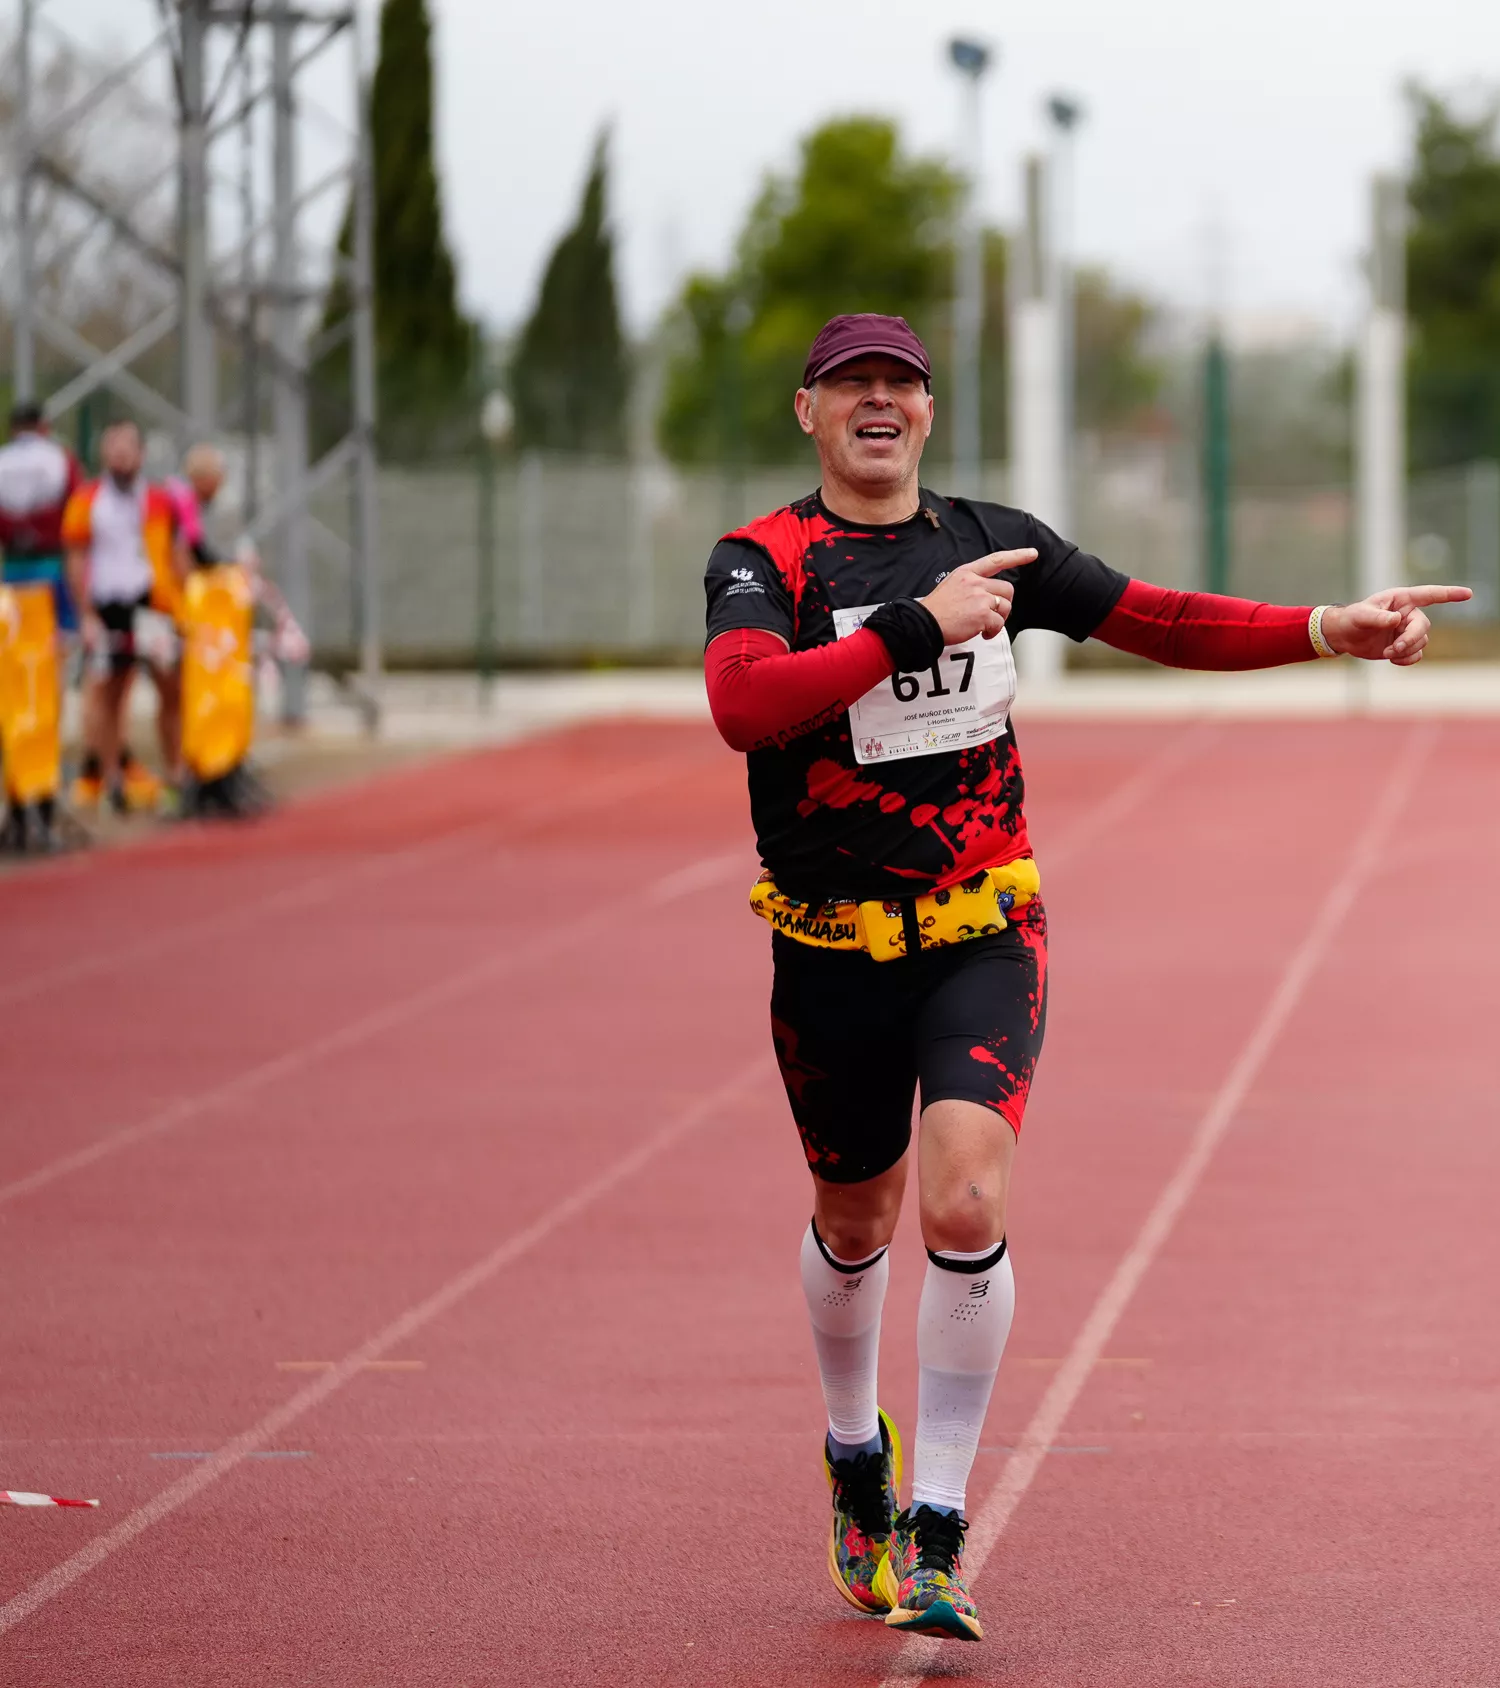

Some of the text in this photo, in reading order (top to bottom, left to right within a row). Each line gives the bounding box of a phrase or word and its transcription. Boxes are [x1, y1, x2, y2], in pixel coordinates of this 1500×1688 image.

[891, 651, 975, 702] 617
[904, 713, 920, 721] JOSÉ
[919, 710, 942, 719] MUÑOZ
[954, 704, 976, 712] MORAL
[927, 717, 955, 726] L-Hombre
[772, 908, 856, 943] KAMUABU
